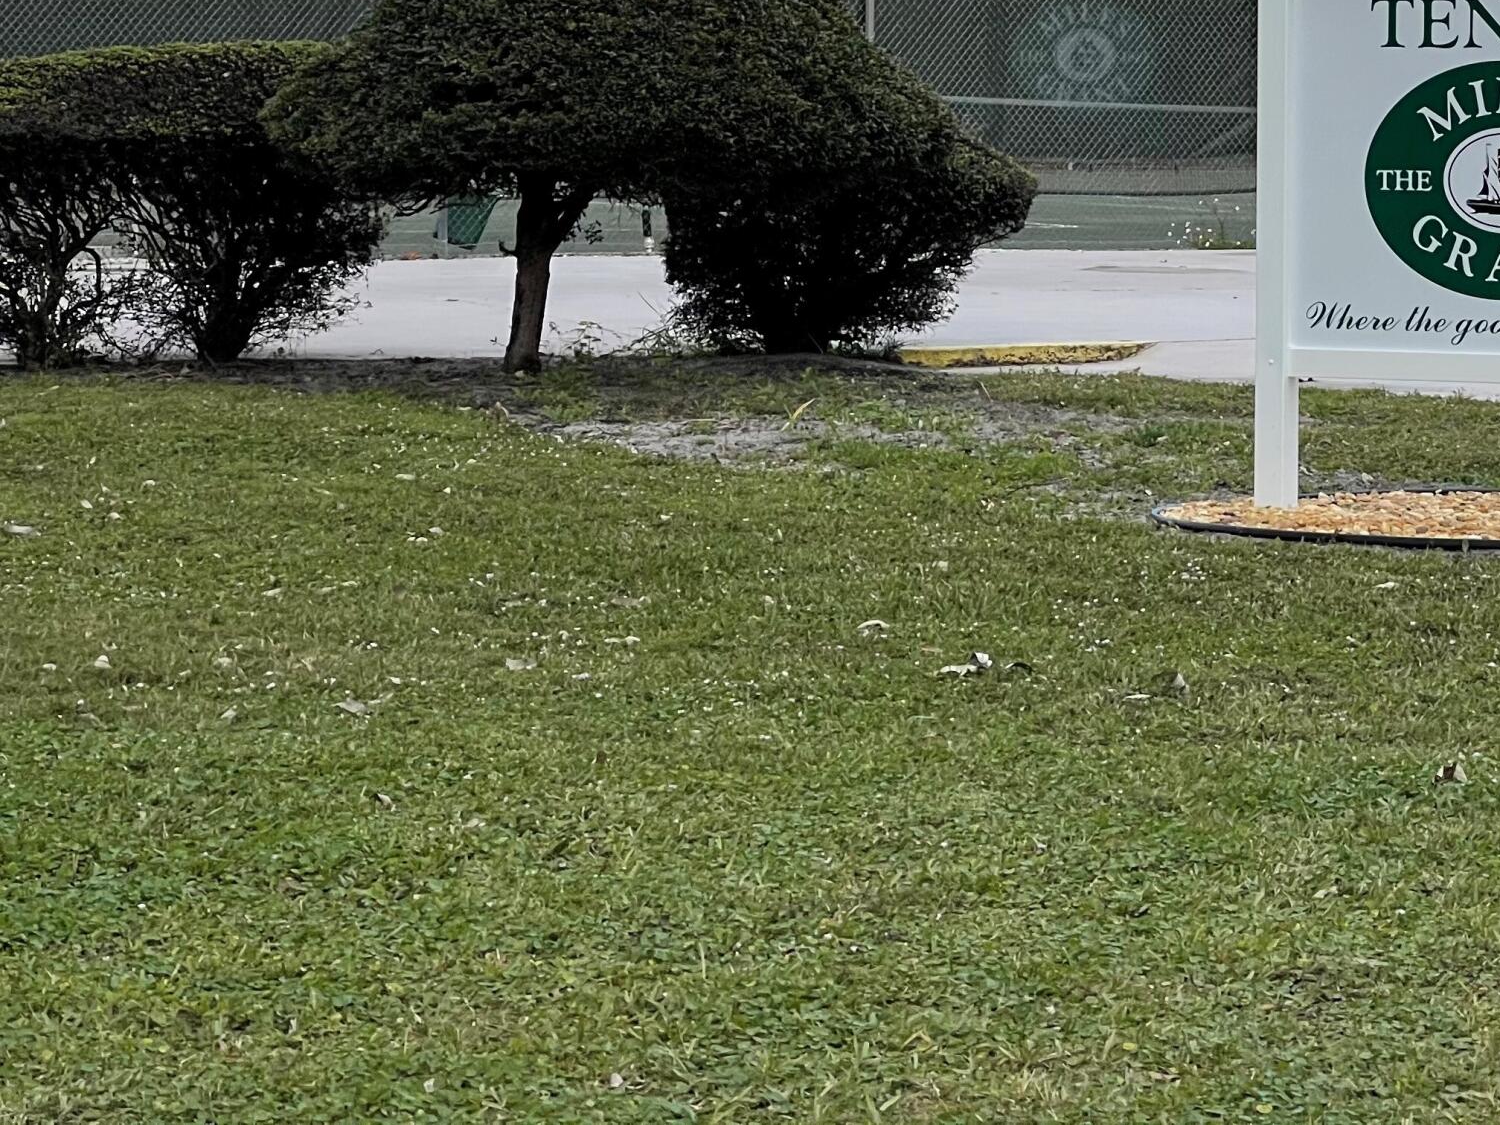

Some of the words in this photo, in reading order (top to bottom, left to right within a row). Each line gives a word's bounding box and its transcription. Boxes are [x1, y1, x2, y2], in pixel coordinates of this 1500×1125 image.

[1376, 170, 1432, 191] THE
[1306, 301, 1398, 331] Where
[1405, 306, 1450, 333] the
